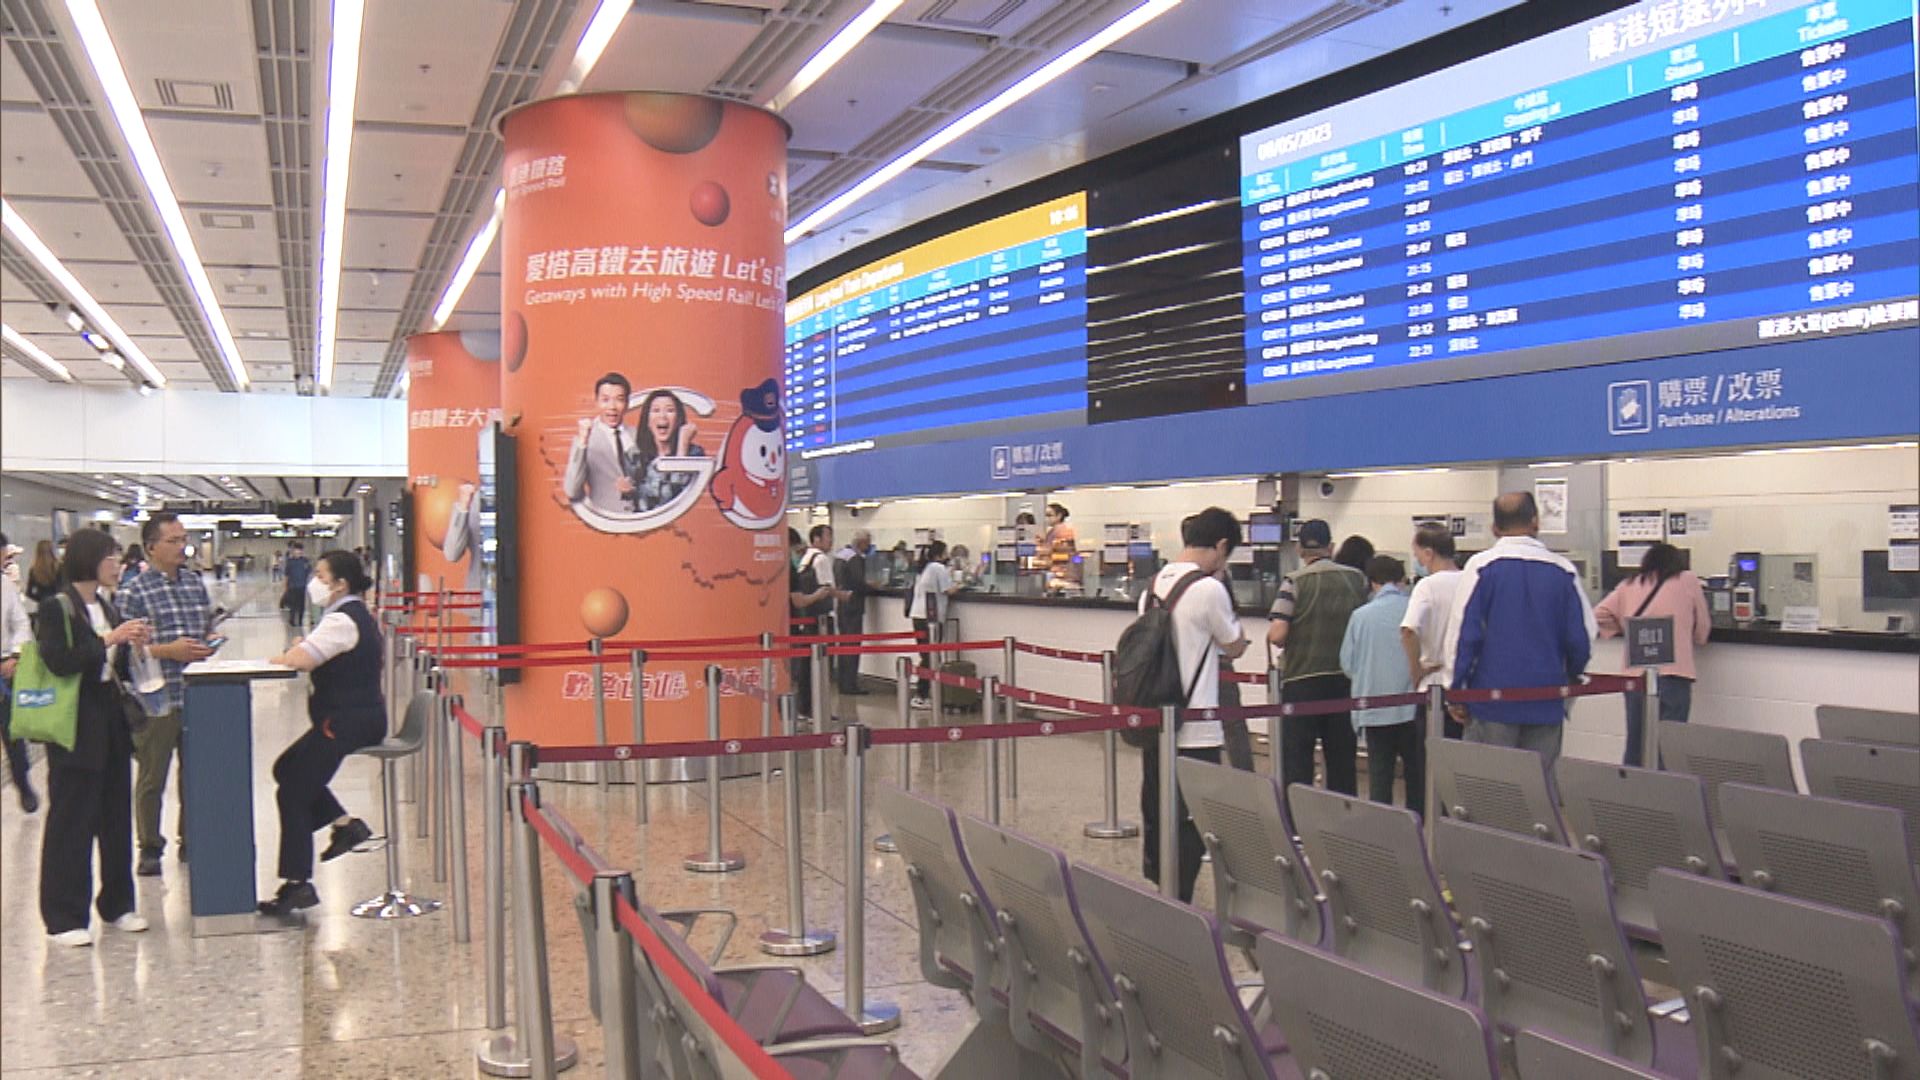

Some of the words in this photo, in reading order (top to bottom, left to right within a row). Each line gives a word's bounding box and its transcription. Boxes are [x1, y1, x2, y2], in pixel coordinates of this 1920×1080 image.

[525, 286, 585, 306] Getaways
[592, 284, 626, 299] with
[633, 284, 671, 304] High
[678, 284, 723, 302] Speed
[1657, 412, 1714, 428] Purchase
[1725, 405, 1801, 424] Alterations
